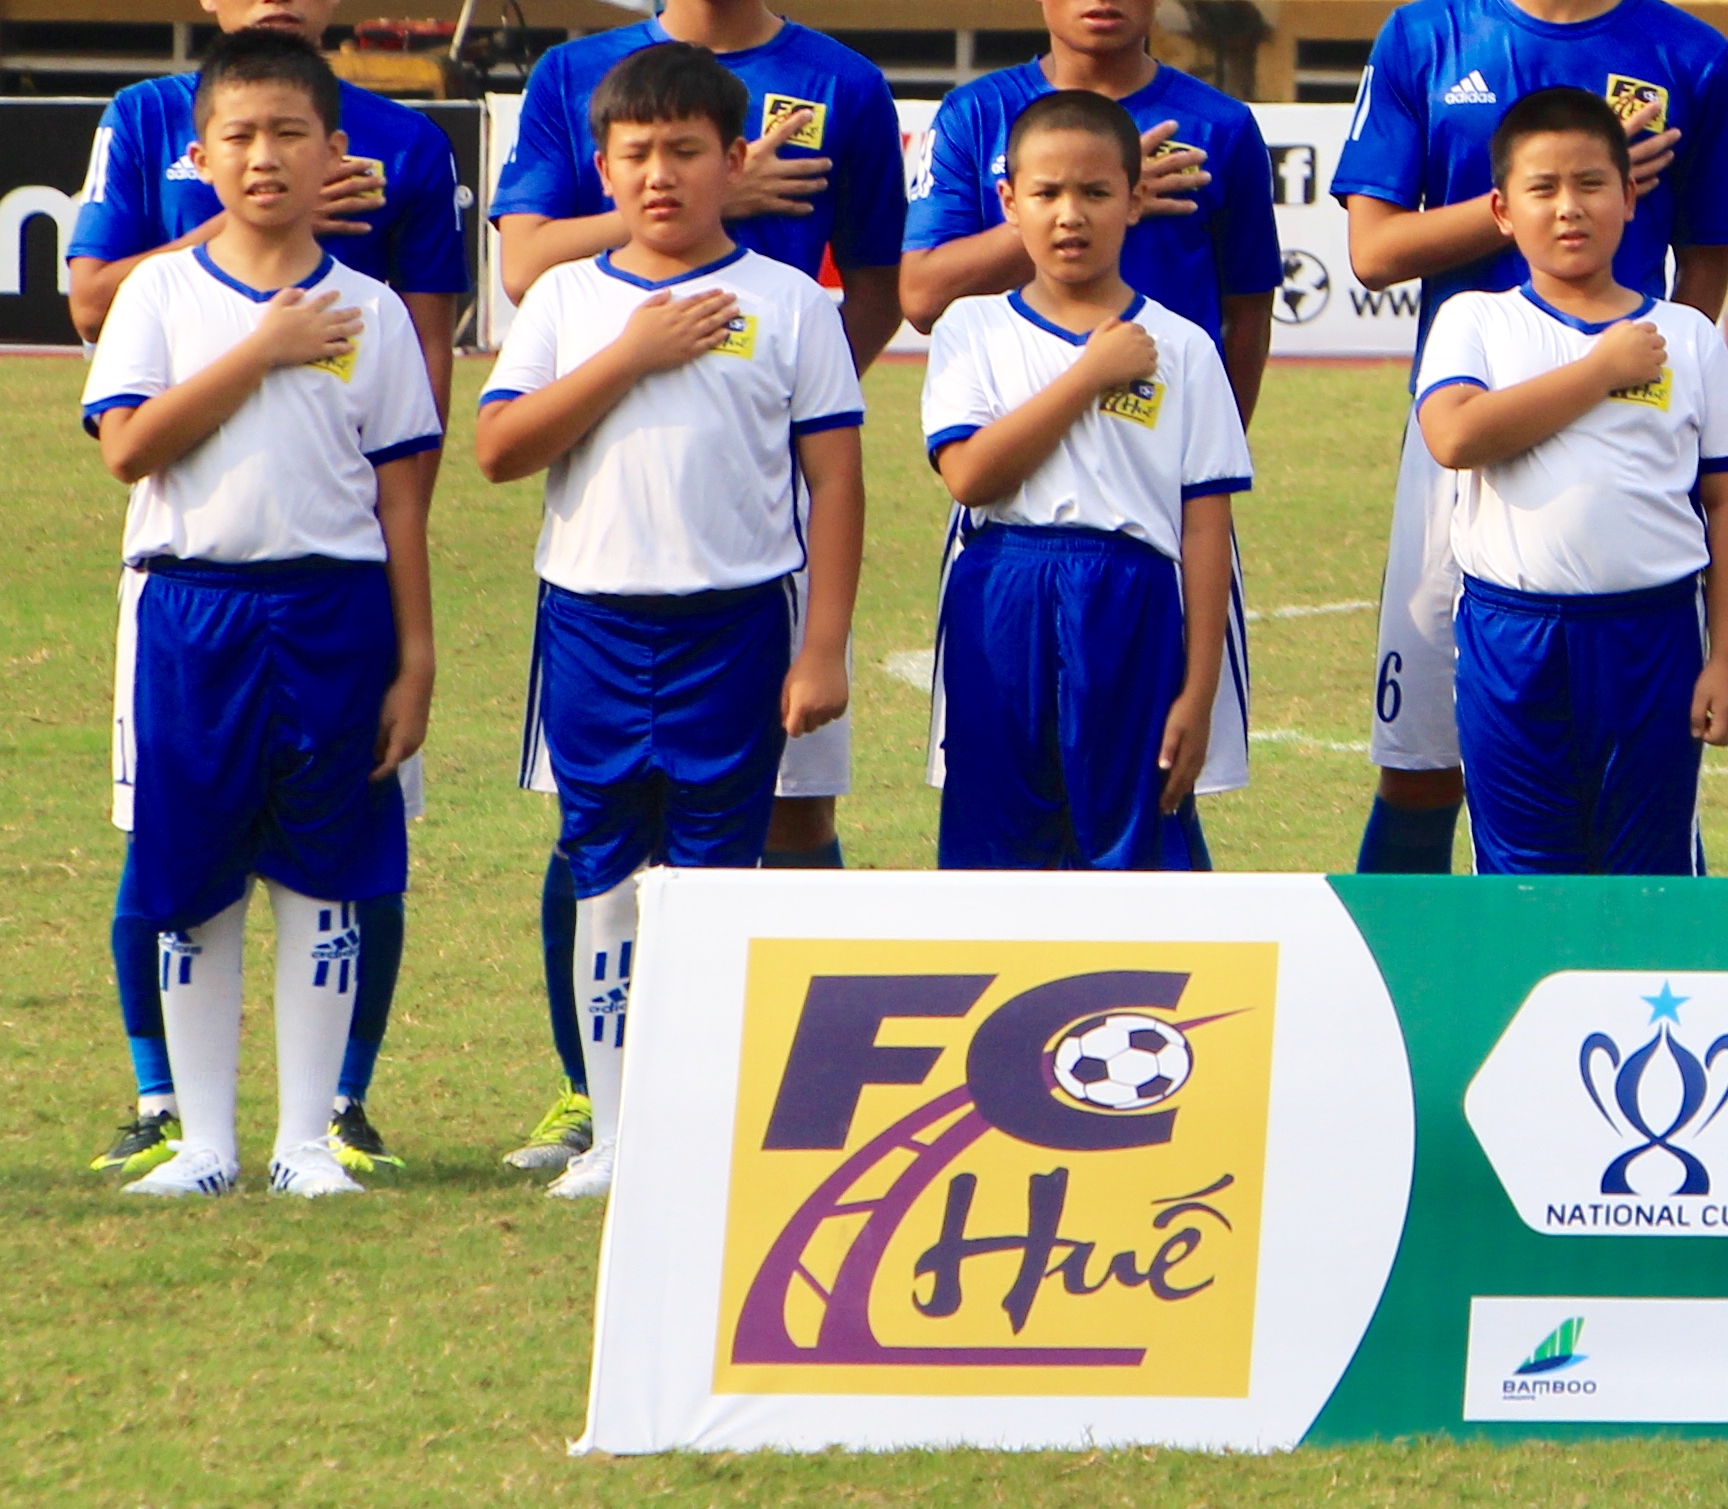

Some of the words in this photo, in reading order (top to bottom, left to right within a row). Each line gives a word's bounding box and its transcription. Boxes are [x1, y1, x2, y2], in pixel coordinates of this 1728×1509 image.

[1376, 651, 1402, 723] 6
[761, 970, 1194, 1153] FC
[1546, 1203, 1691, 1227] NATIONAL
[912, 1167, 1235, 1336] Huế
[1502, 1379, 1597, 1395] BAMBOO
